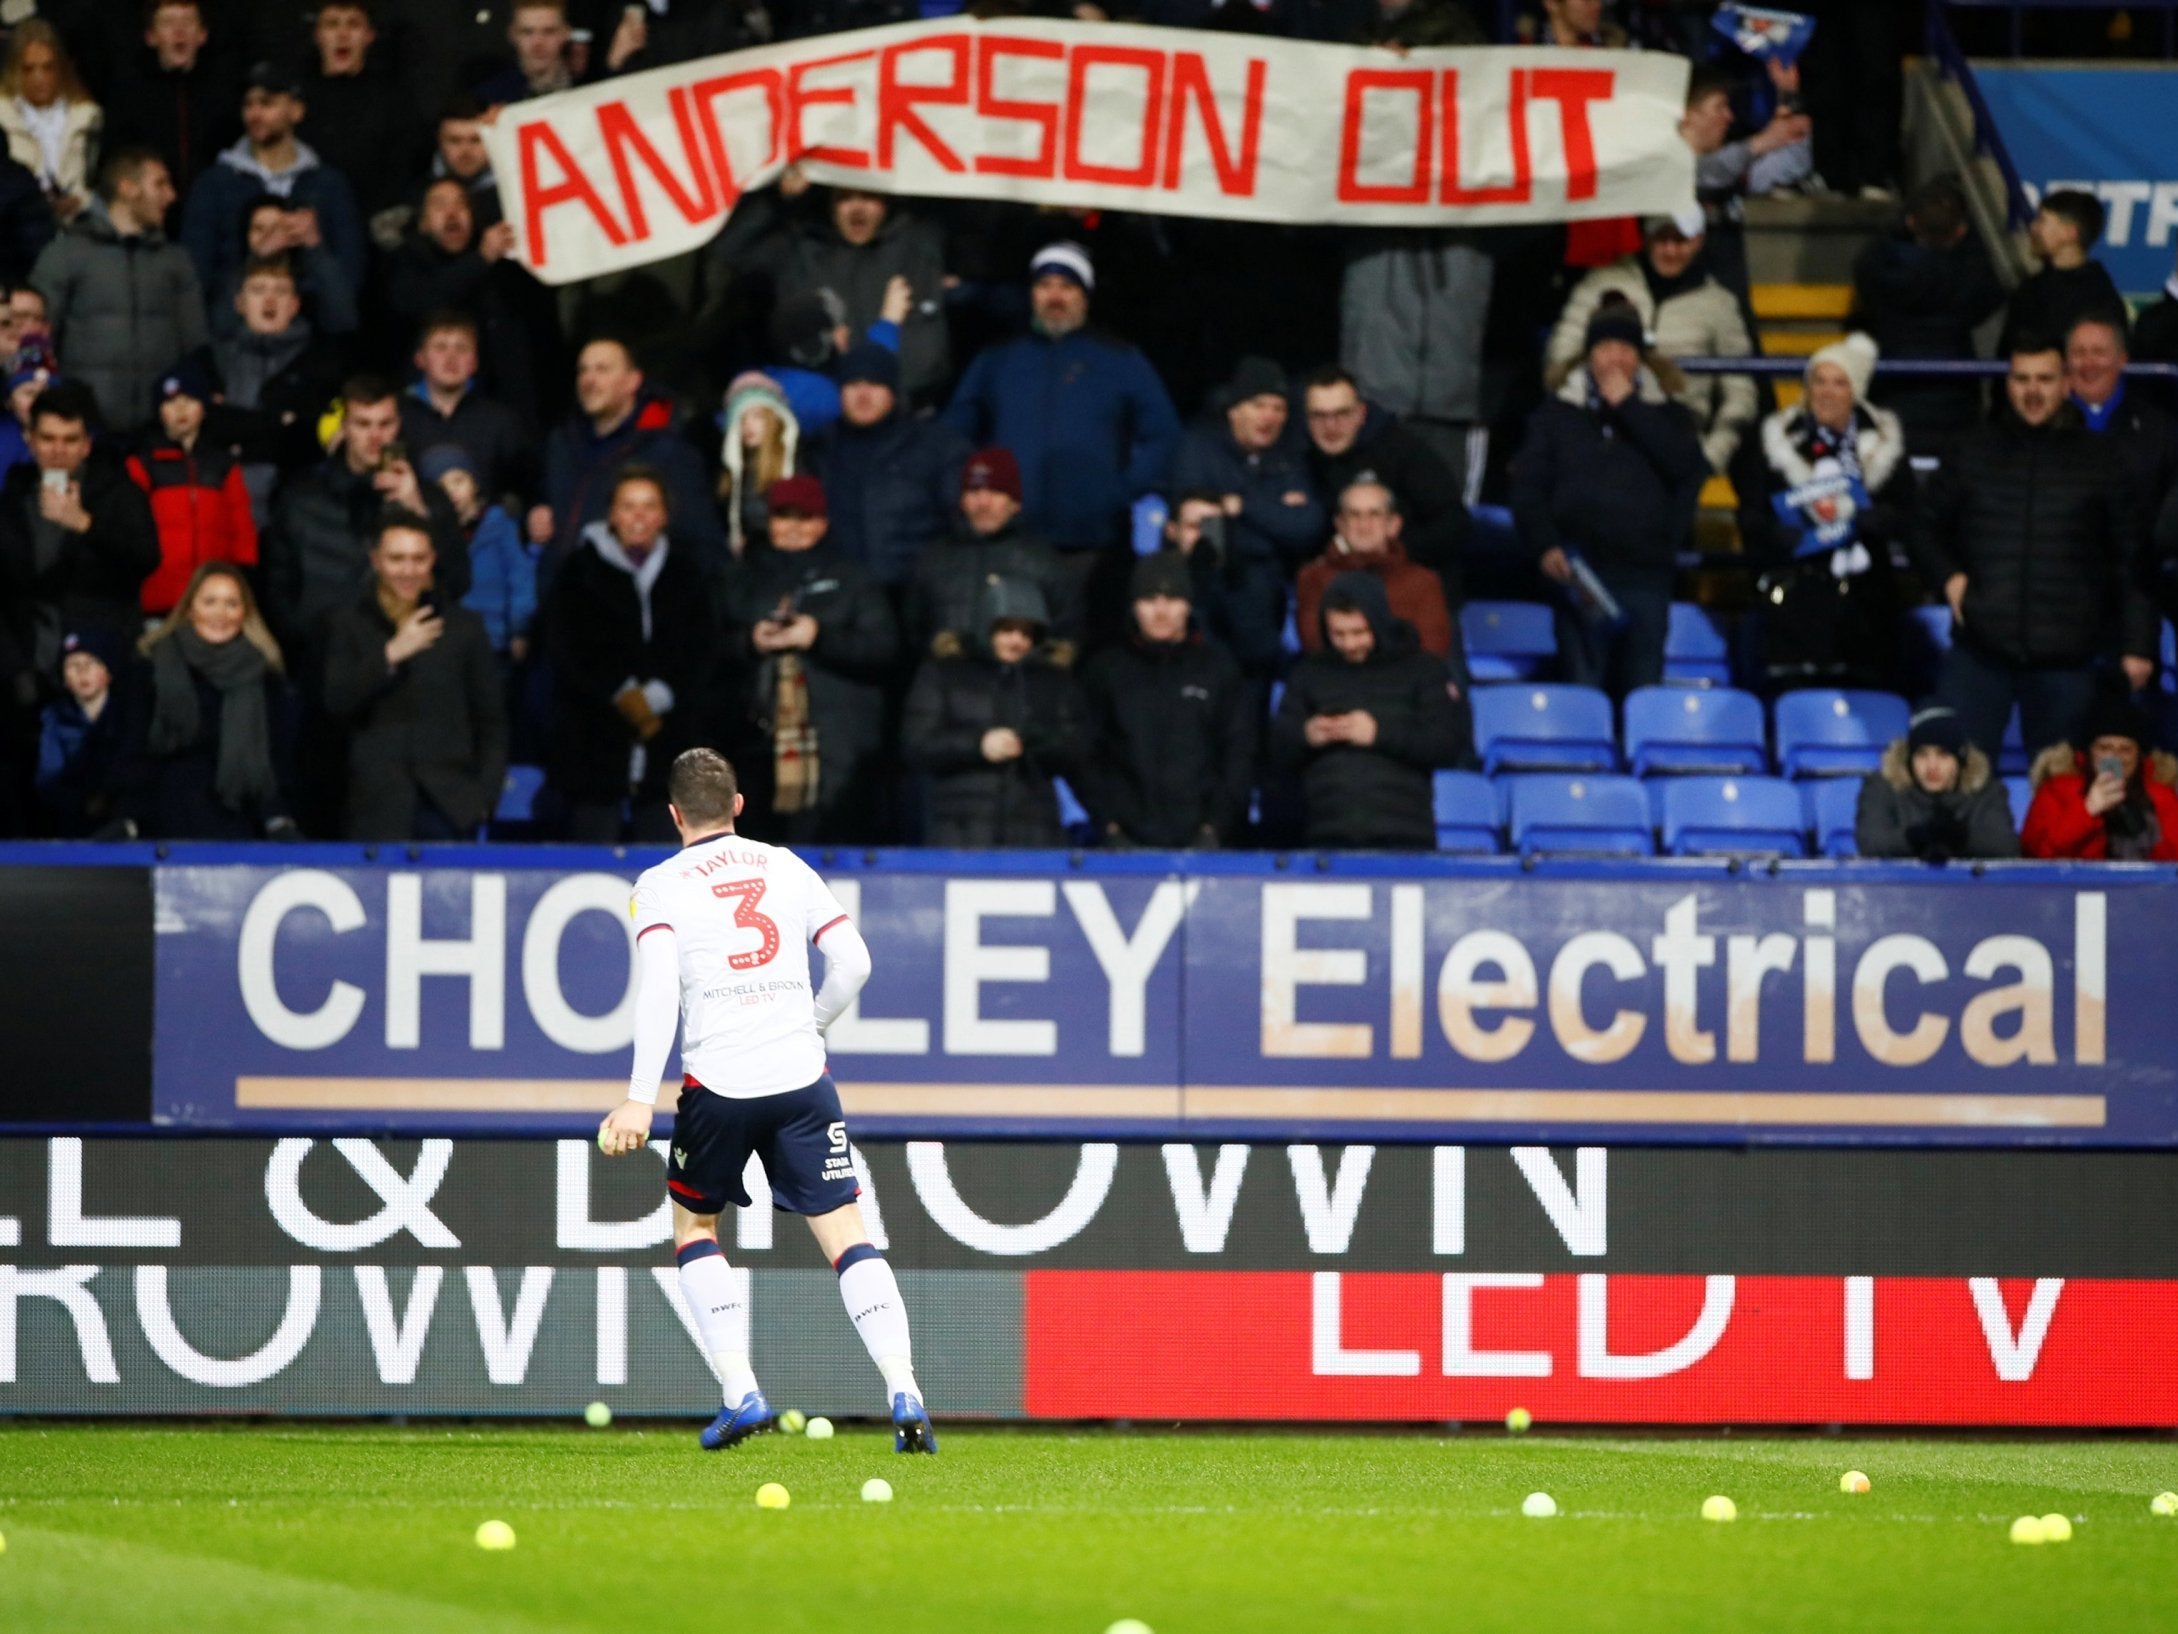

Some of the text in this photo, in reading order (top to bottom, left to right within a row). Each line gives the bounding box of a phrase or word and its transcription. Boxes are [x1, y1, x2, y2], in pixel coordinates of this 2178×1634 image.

[517, 34, 1616, 266] ANDERSON OUT
[695, 849, 769, 877] TAYLOR
[239, 870, 2107, 1067] CHOLEY Electrical
[711, 877, 780, 970] 3
[703, 980, 805, 1000] MITCHELL & BROWN
[739, 992, 776, 1006] LED TV
[556, 1139, 1608, 1257] OWN
[854, 1301, 891, 1323] BWFC
[1311, 1271, 1736, 1381] LED
